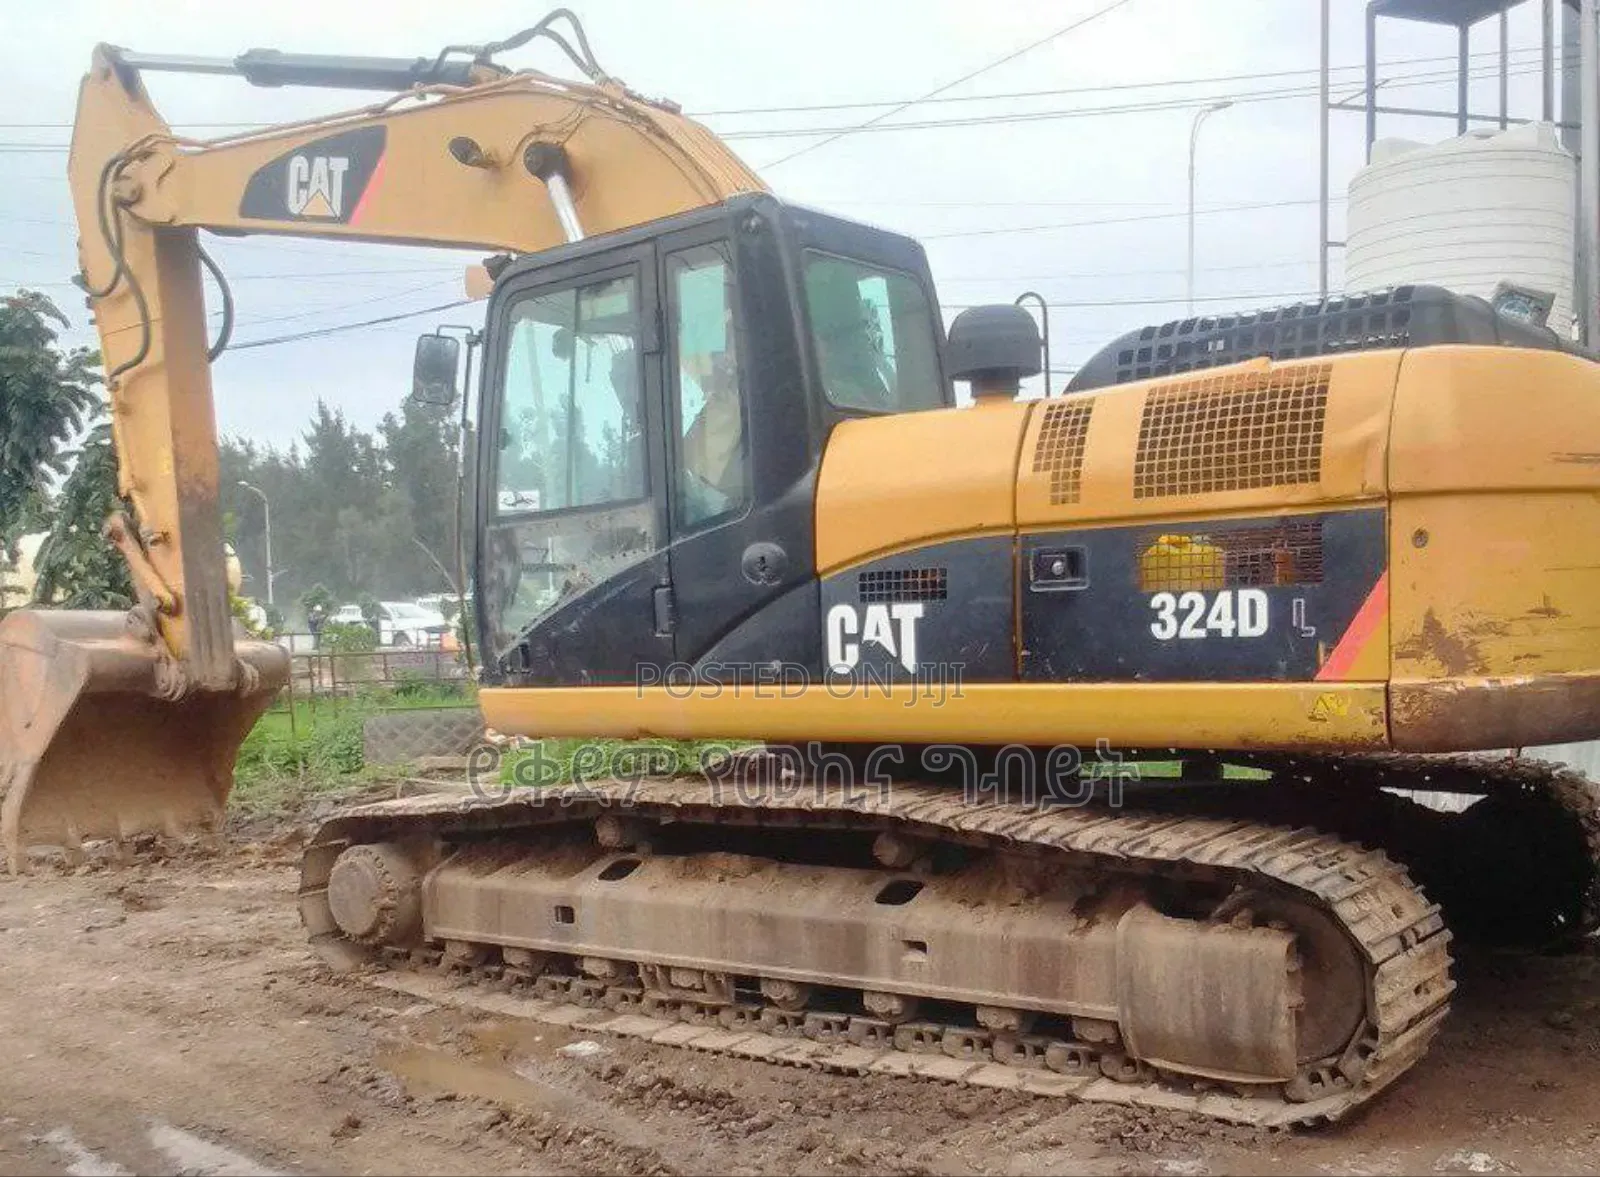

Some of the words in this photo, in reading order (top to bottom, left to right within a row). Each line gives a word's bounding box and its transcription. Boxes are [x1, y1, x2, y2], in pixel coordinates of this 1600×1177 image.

[287, 155, 349, 218] CAT
[827, 602, 924, 675] CAT
[1150, 588, 1270, 641] 324D
